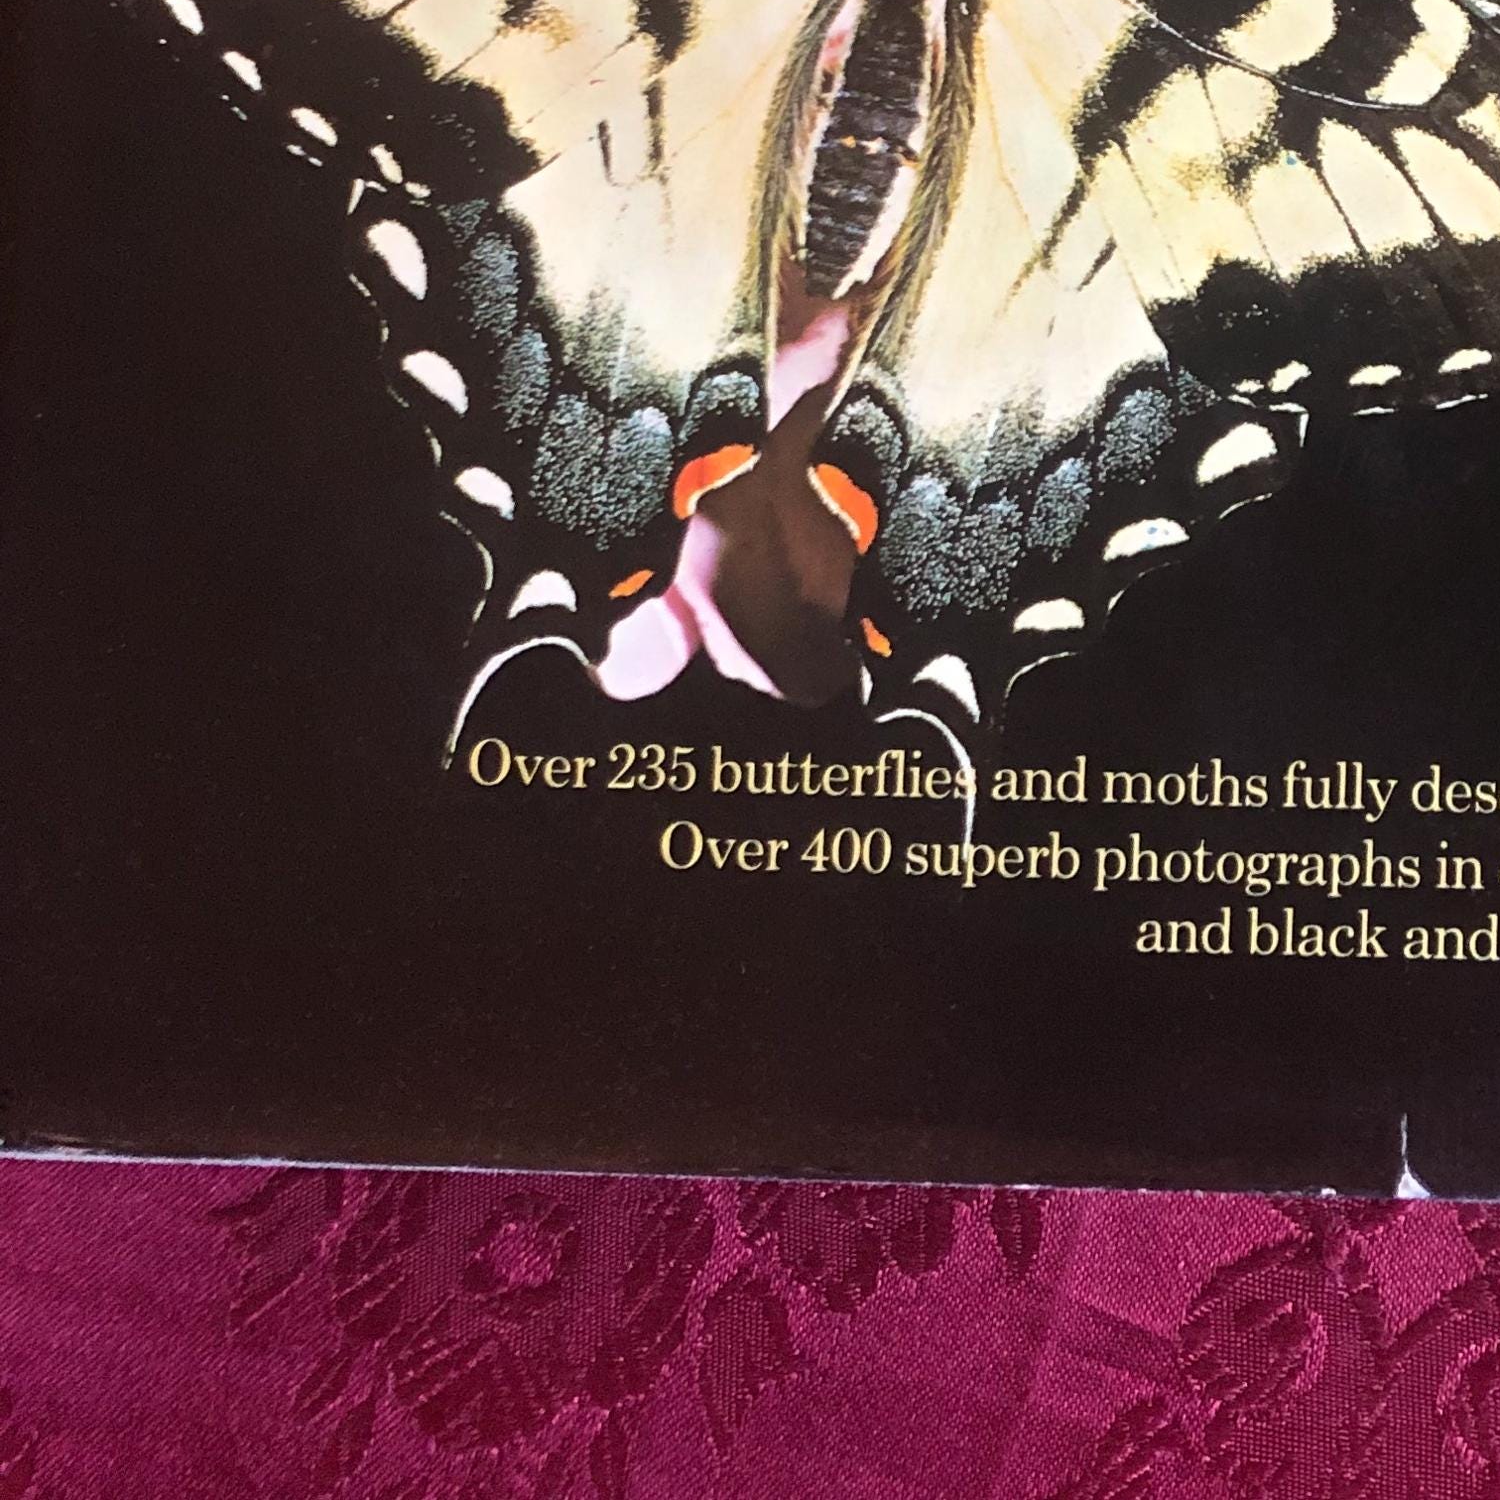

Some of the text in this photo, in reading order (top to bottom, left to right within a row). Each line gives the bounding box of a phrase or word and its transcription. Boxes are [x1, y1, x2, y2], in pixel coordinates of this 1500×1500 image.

[467, 736, 597, 790] Over
[606, 742, 698, 794] 235
[710, 744, 978, 802] butterflies
[990, 754, 1090, 804] and
[1102, 756, 1270, 810] moths
[1280, 758, 1399, 824] fully
[658, 818, 790, 874] Over
[799, 826, 892, 877] 400
[904, 830, 1082, 890] superb
[1092, 830, 1422, 900] photographs
[1435, 838, 1486, 892] in
[1134, 906, 1234, 956] and
[1246, 906, 1390, 960] black
